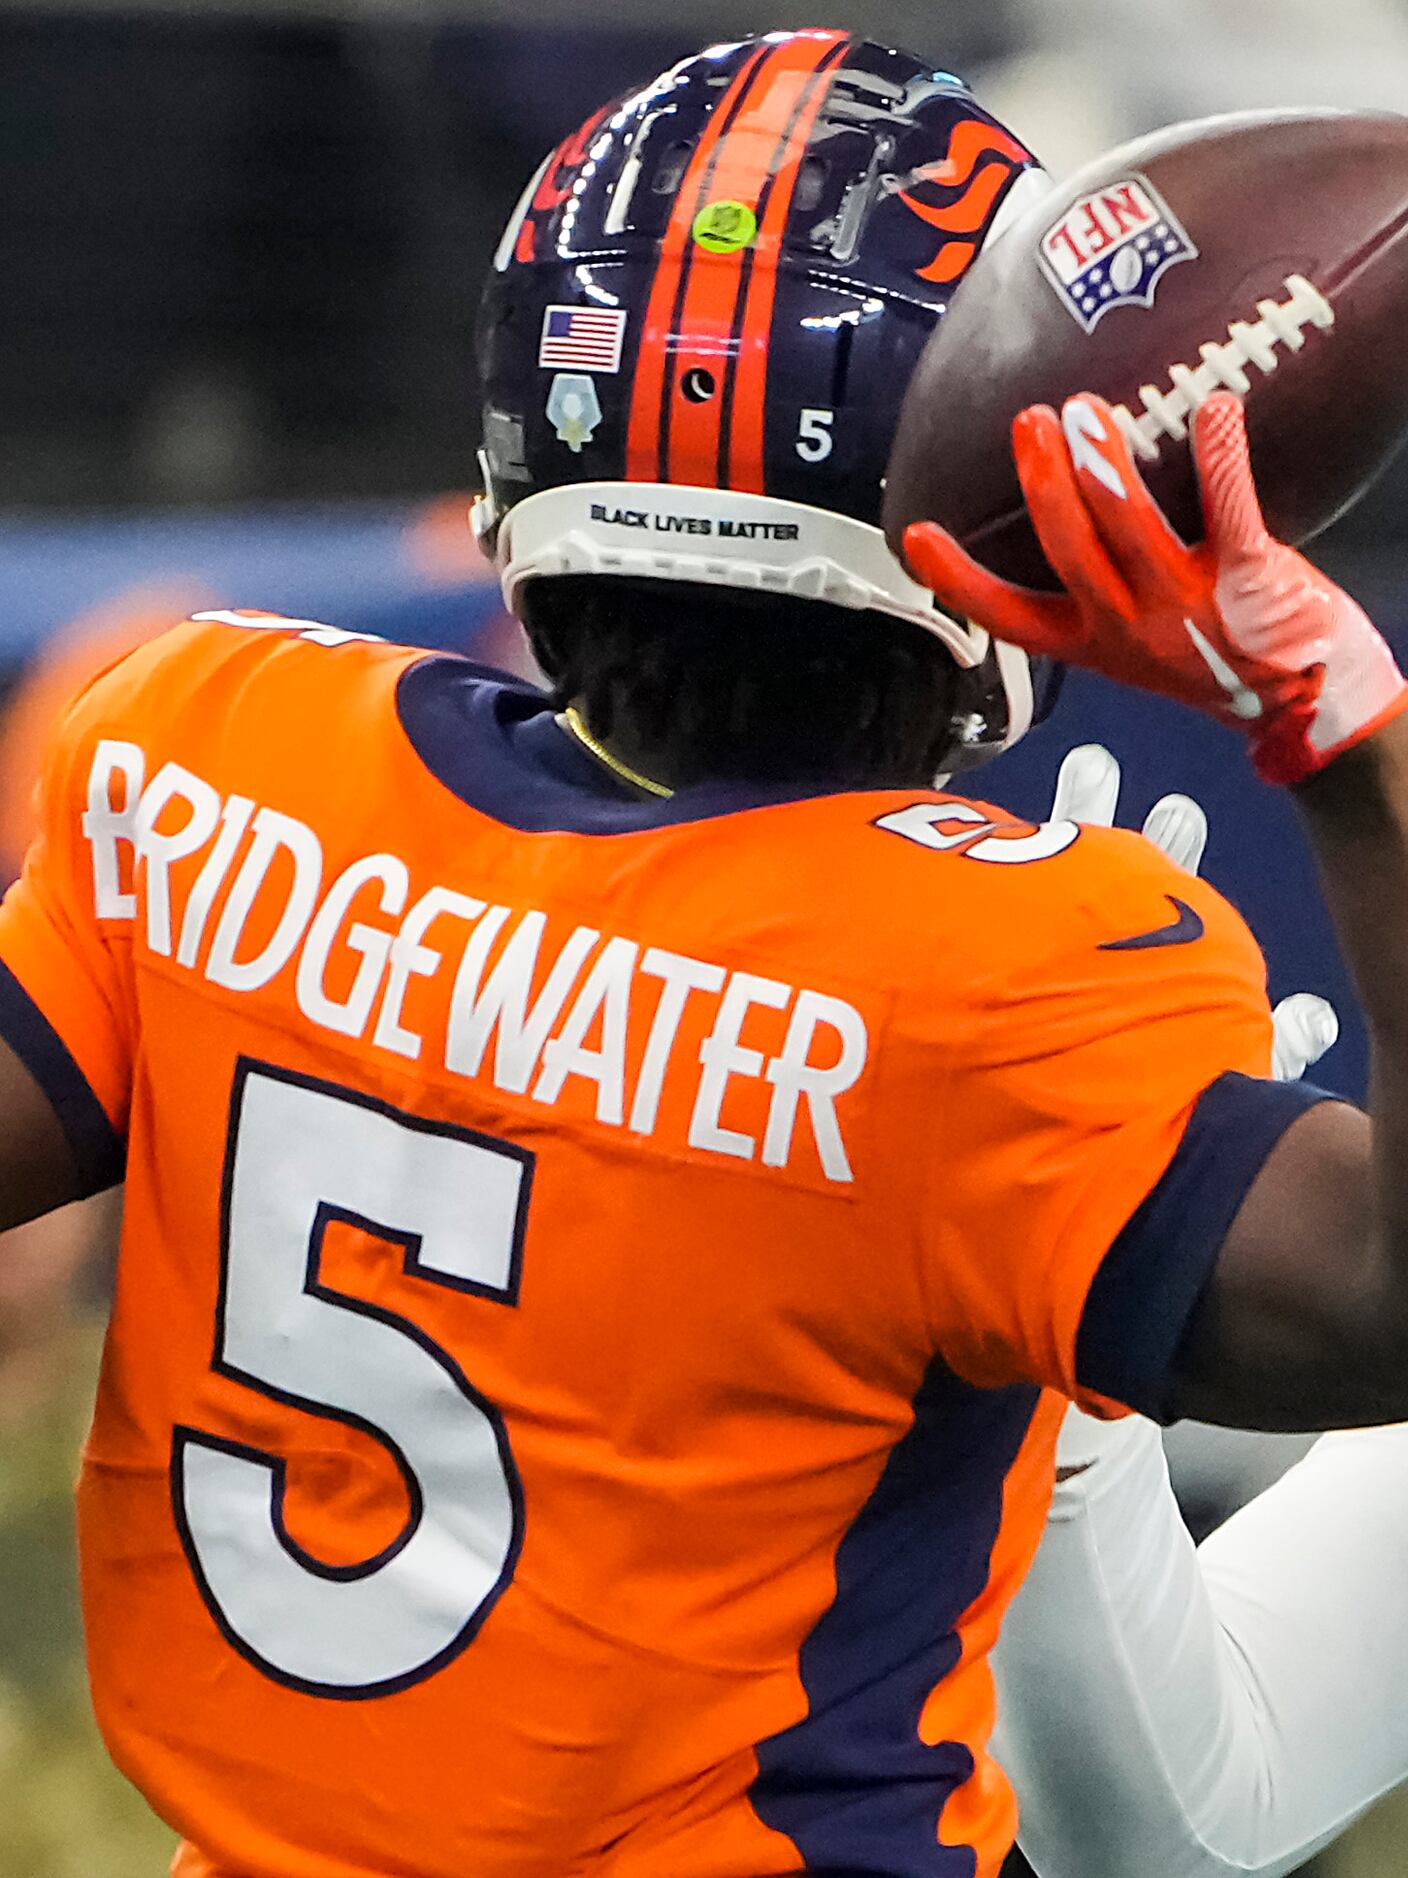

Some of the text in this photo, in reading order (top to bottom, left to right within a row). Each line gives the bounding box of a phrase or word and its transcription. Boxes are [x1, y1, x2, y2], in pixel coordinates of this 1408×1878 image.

[1049, 186, 1149, 267] NFL
[795, 408, 834, 463] 5
[590, 504, 799, 541] BLACK LIVES MATTER
[82, 739, 869, 1184] BRIDGEWATER
[171, 1055, 537, 1700] 5
